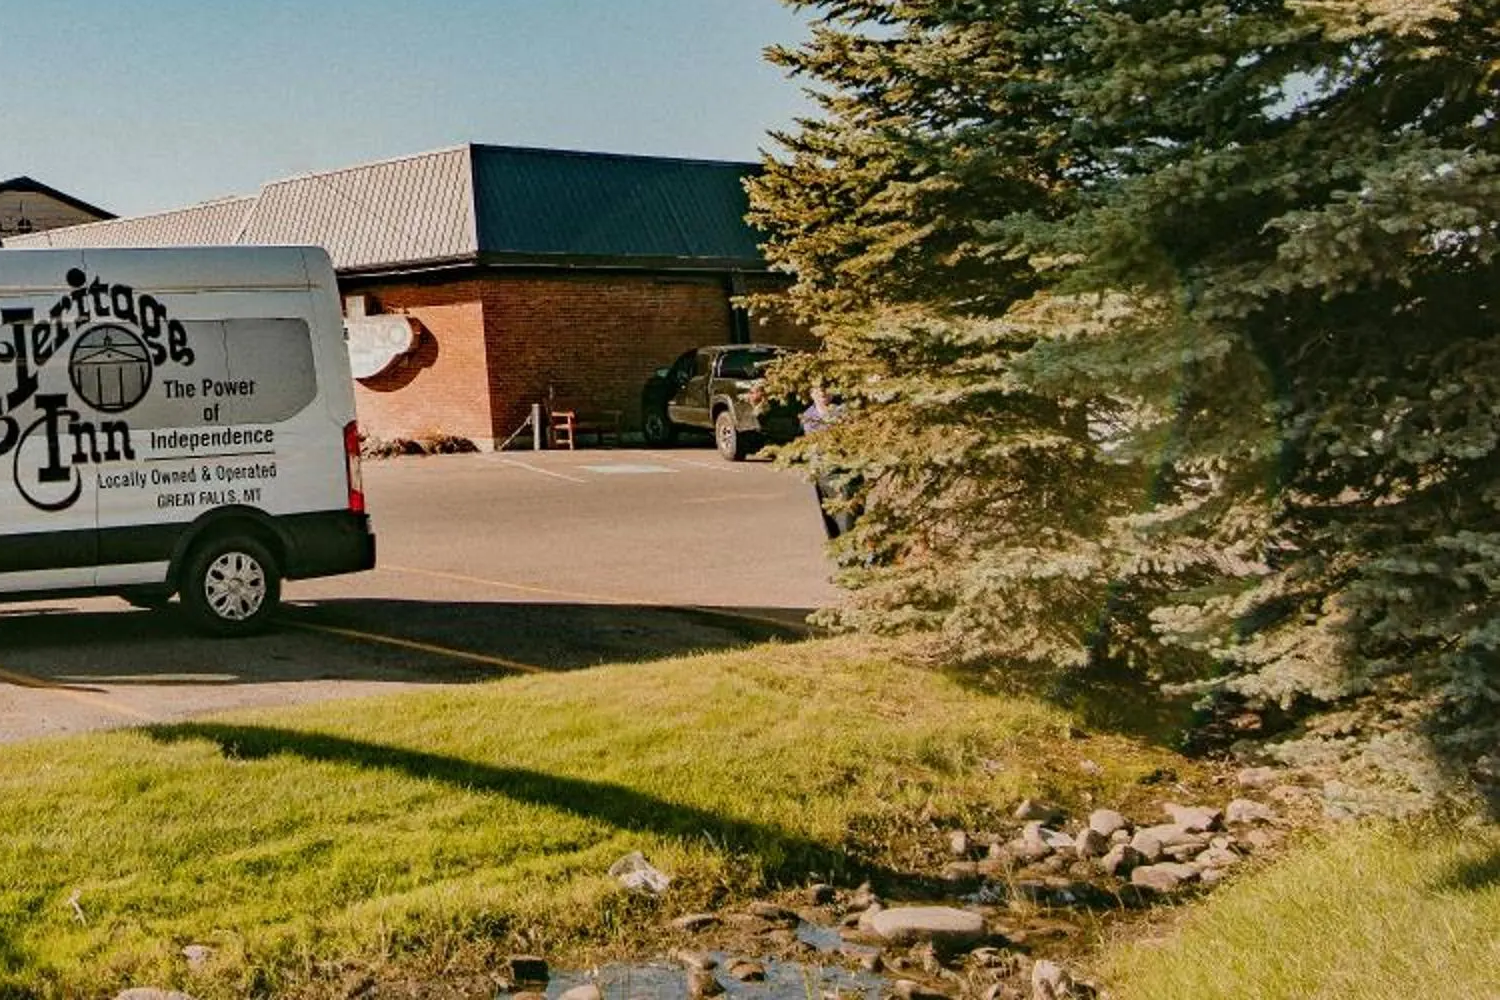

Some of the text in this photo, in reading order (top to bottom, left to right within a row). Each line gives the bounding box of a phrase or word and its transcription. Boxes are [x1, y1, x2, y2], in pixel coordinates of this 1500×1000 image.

[164, 378, 257, 399] The Power
[203, 403, 221, 422] of
[151, 427, 275, 451] Independence
[13, 393, 135, 511] Inn
[98, 462, 277, 489] Locally Owned & Operated
[157, 491, 196, 508] GREAT
